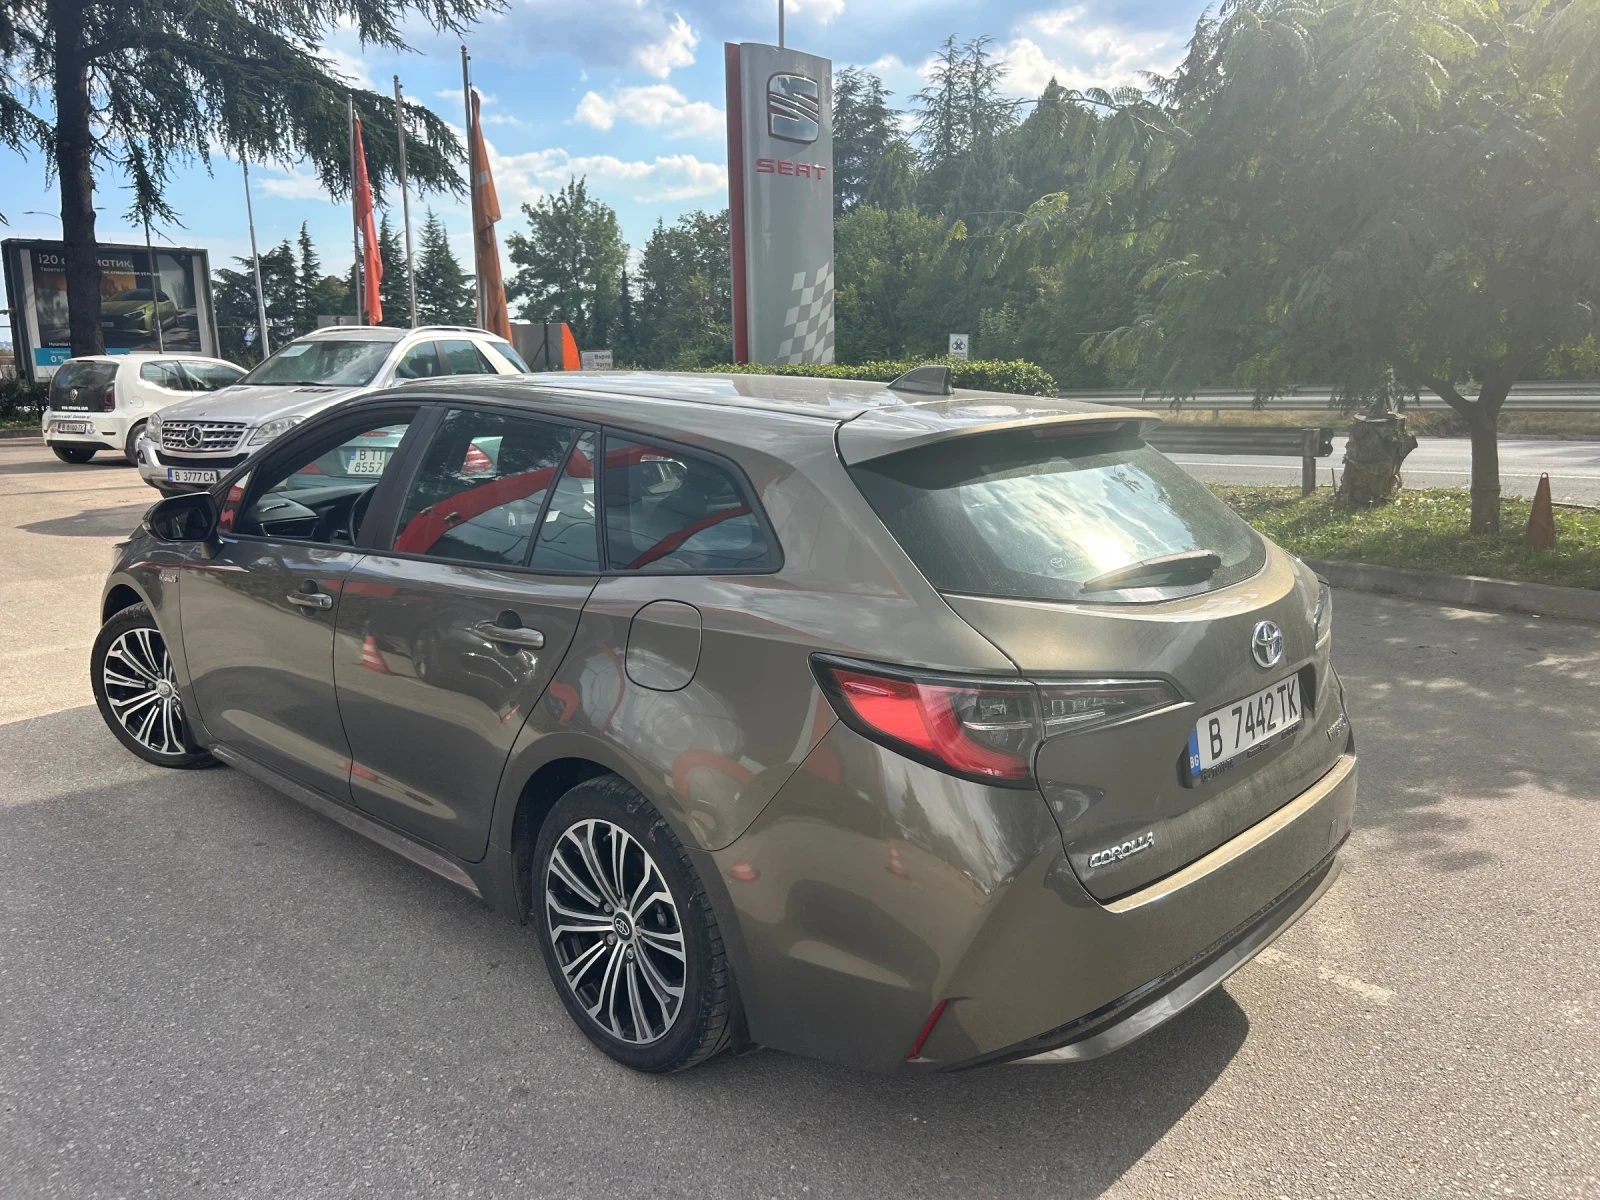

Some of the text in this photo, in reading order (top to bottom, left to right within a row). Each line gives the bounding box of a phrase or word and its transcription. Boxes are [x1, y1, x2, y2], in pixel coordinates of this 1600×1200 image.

[756, 159, 826, 180] SEAT
[38, 254, 59, 265] i20
[360, 449, 385, 461] B TT
[354, 461, 384, 473] 8557
[174, 471, 180, 481] B
[183, 471, 202, 482] 3777
[203, 472, 216, 482] CA
[1208, 717, 1223, 761] B
[1231, 692, 1277, 749] 7442
[1277, 679, 1298, 725] TK
[1190, 754, 1200, 769] BG
[1088, 831, 1154, 868] COROLLA
